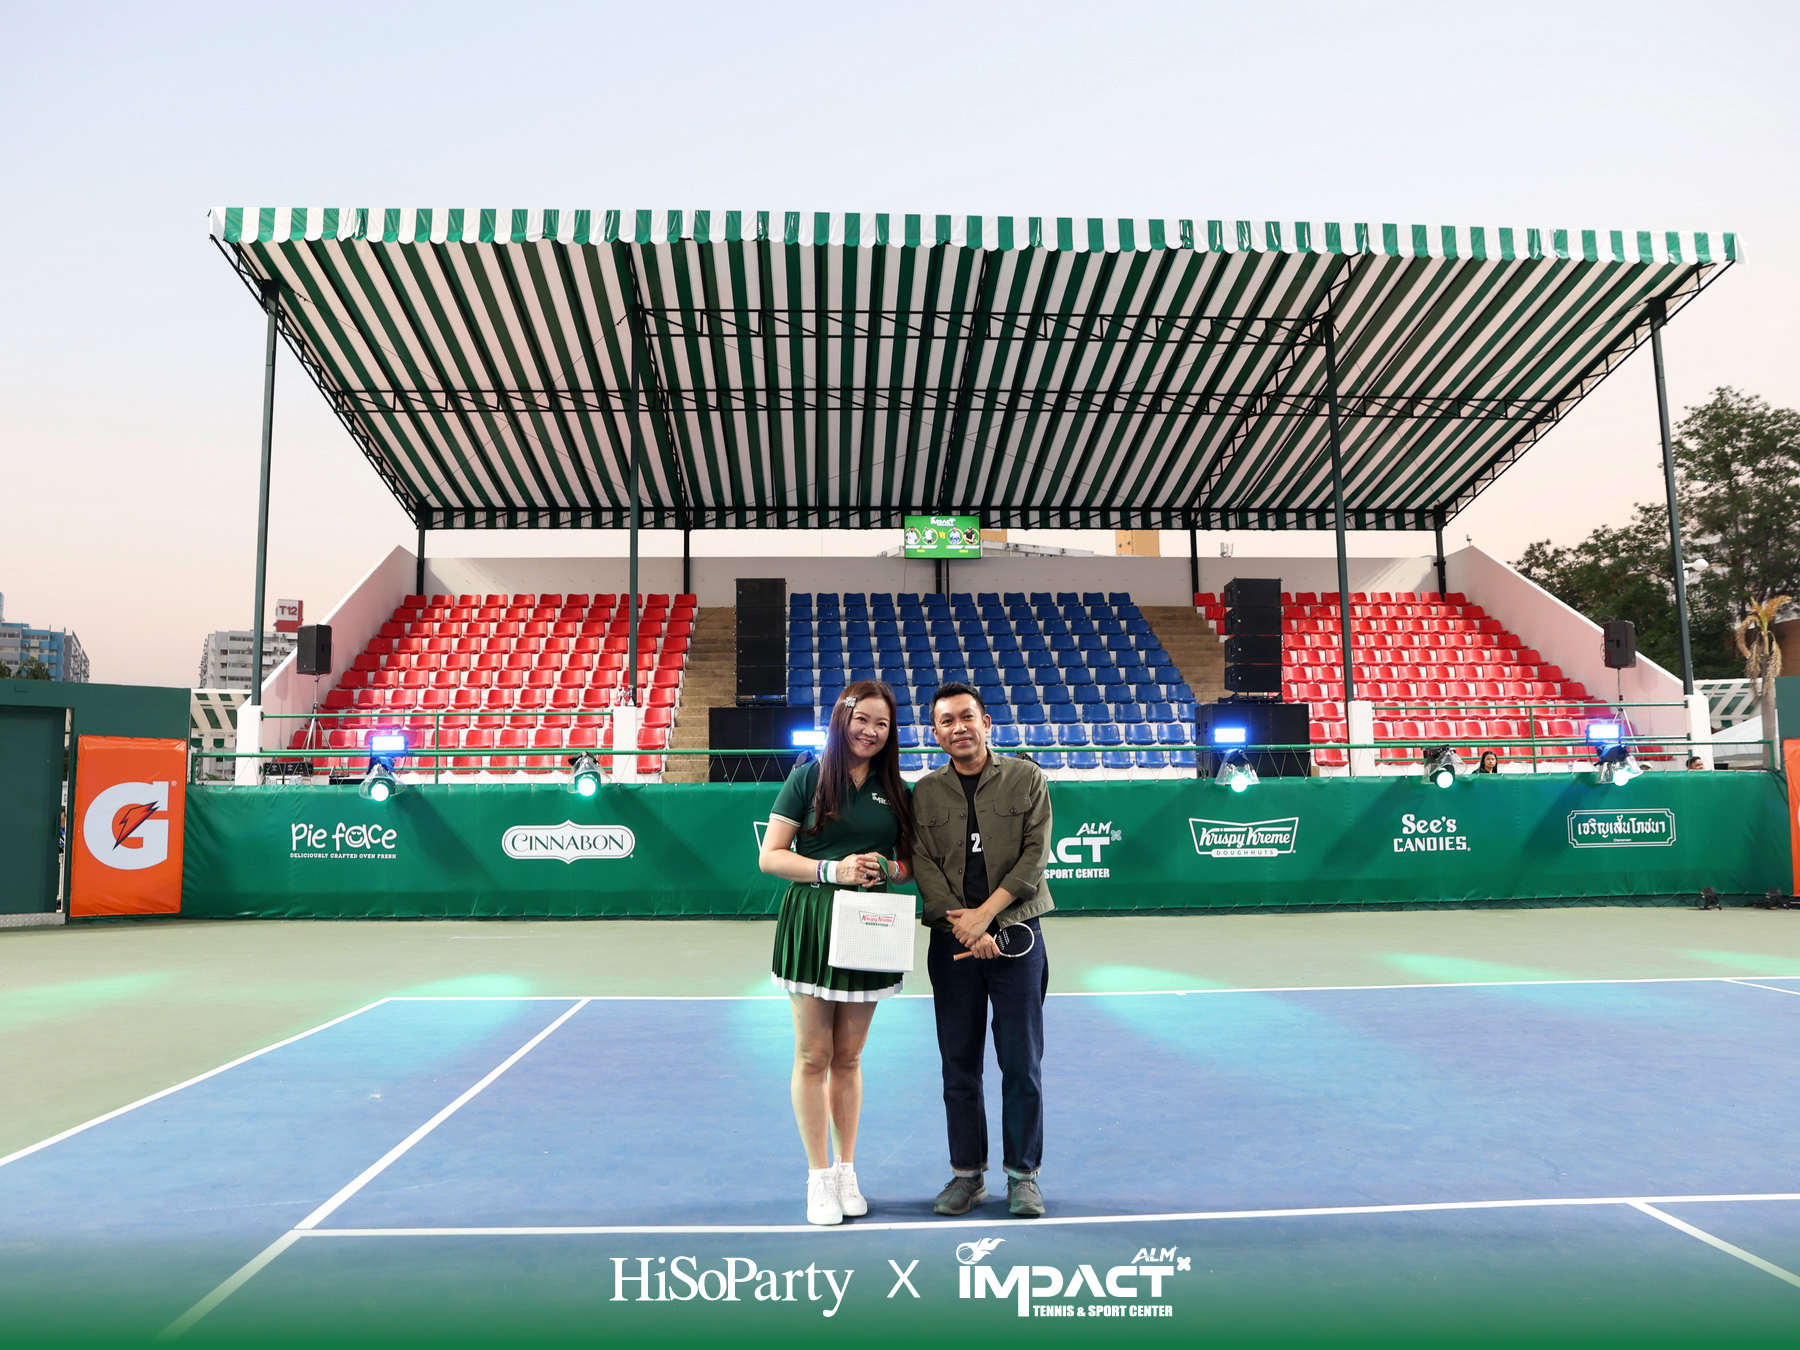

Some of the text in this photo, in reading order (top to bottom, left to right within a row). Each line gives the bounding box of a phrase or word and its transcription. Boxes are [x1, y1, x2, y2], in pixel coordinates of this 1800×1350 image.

[279, 606, 298, 616] T12
[83, 781, 169, 870] G
[1075, 820, 1113, 836] ALM
[1401, 813, 1457, 834] See's
[1577, 815, 1667, 838] เจริญเส้นโภชนา
[291, 822, 397, 851] Pie face
[511, 833, 624, 852] CINNABON
[1199, 826, 1293, 849] Krispy Kreme
[1393, 836, 1467, 852] CANDIES
[1043, 868, 1110, 879] SPORT CENTER
